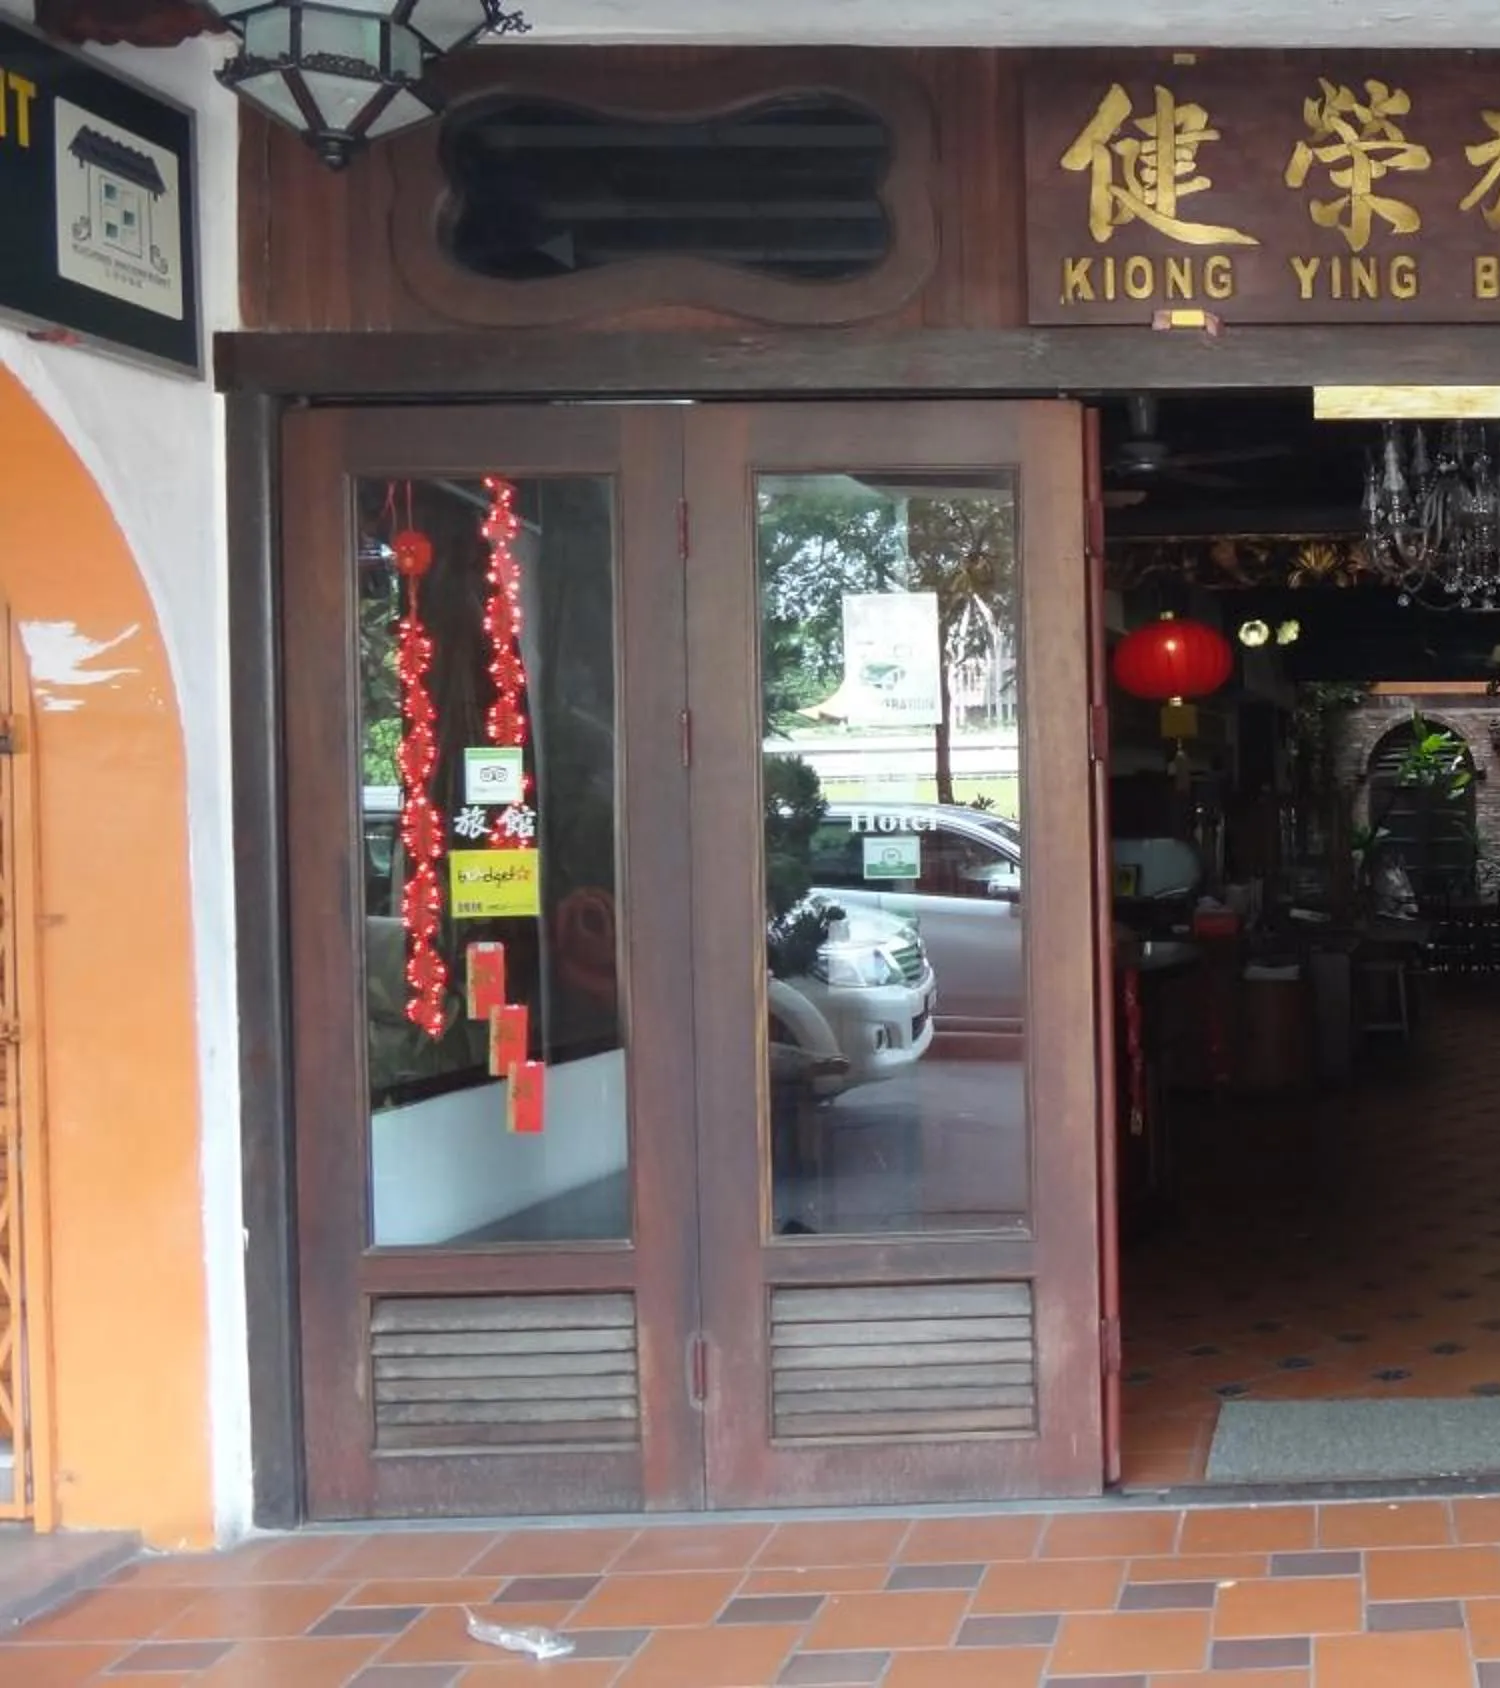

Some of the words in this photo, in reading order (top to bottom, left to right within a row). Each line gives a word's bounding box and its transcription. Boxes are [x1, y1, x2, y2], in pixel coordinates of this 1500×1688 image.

[1062, 255, 1234, 304] KIONG
[1291, 255, 1419, 300] YING
[1474, 257, 1500, 299] B
[453, 805, 537, 839] 旅館
[848, 808, 937, 832] Hotel
